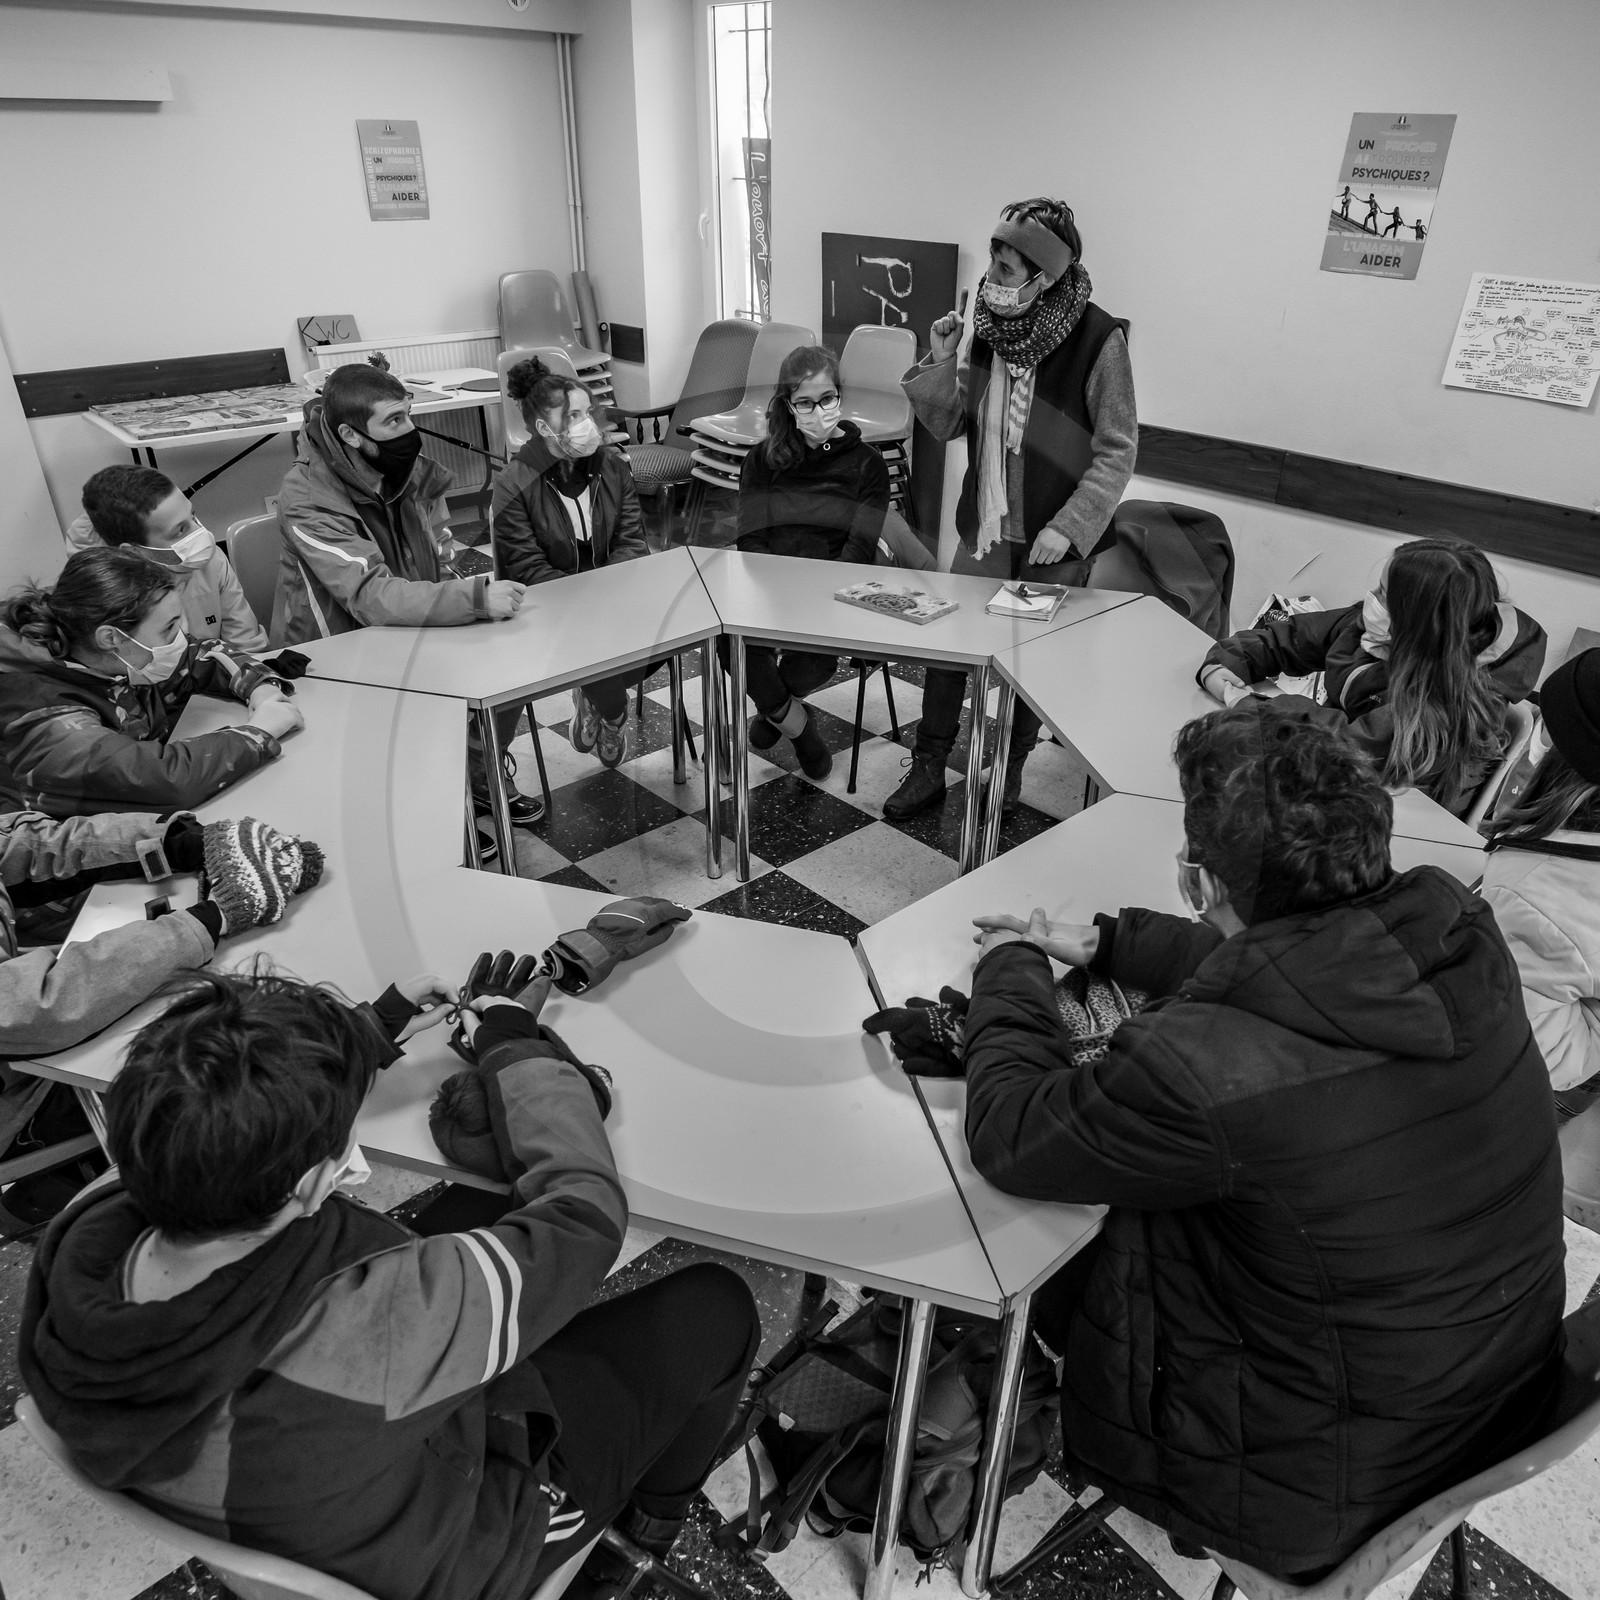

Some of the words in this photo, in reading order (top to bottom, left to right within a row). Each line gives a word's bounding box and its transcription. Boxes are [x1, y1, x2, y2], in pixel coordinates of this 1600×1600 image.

[1359, 139, 1375, 150] UN
[1372, 154, 1433, 166] TROUBLES
[391, 192, 420, 201] AIDER
[1360, 253, 1401, 268] AIDER
